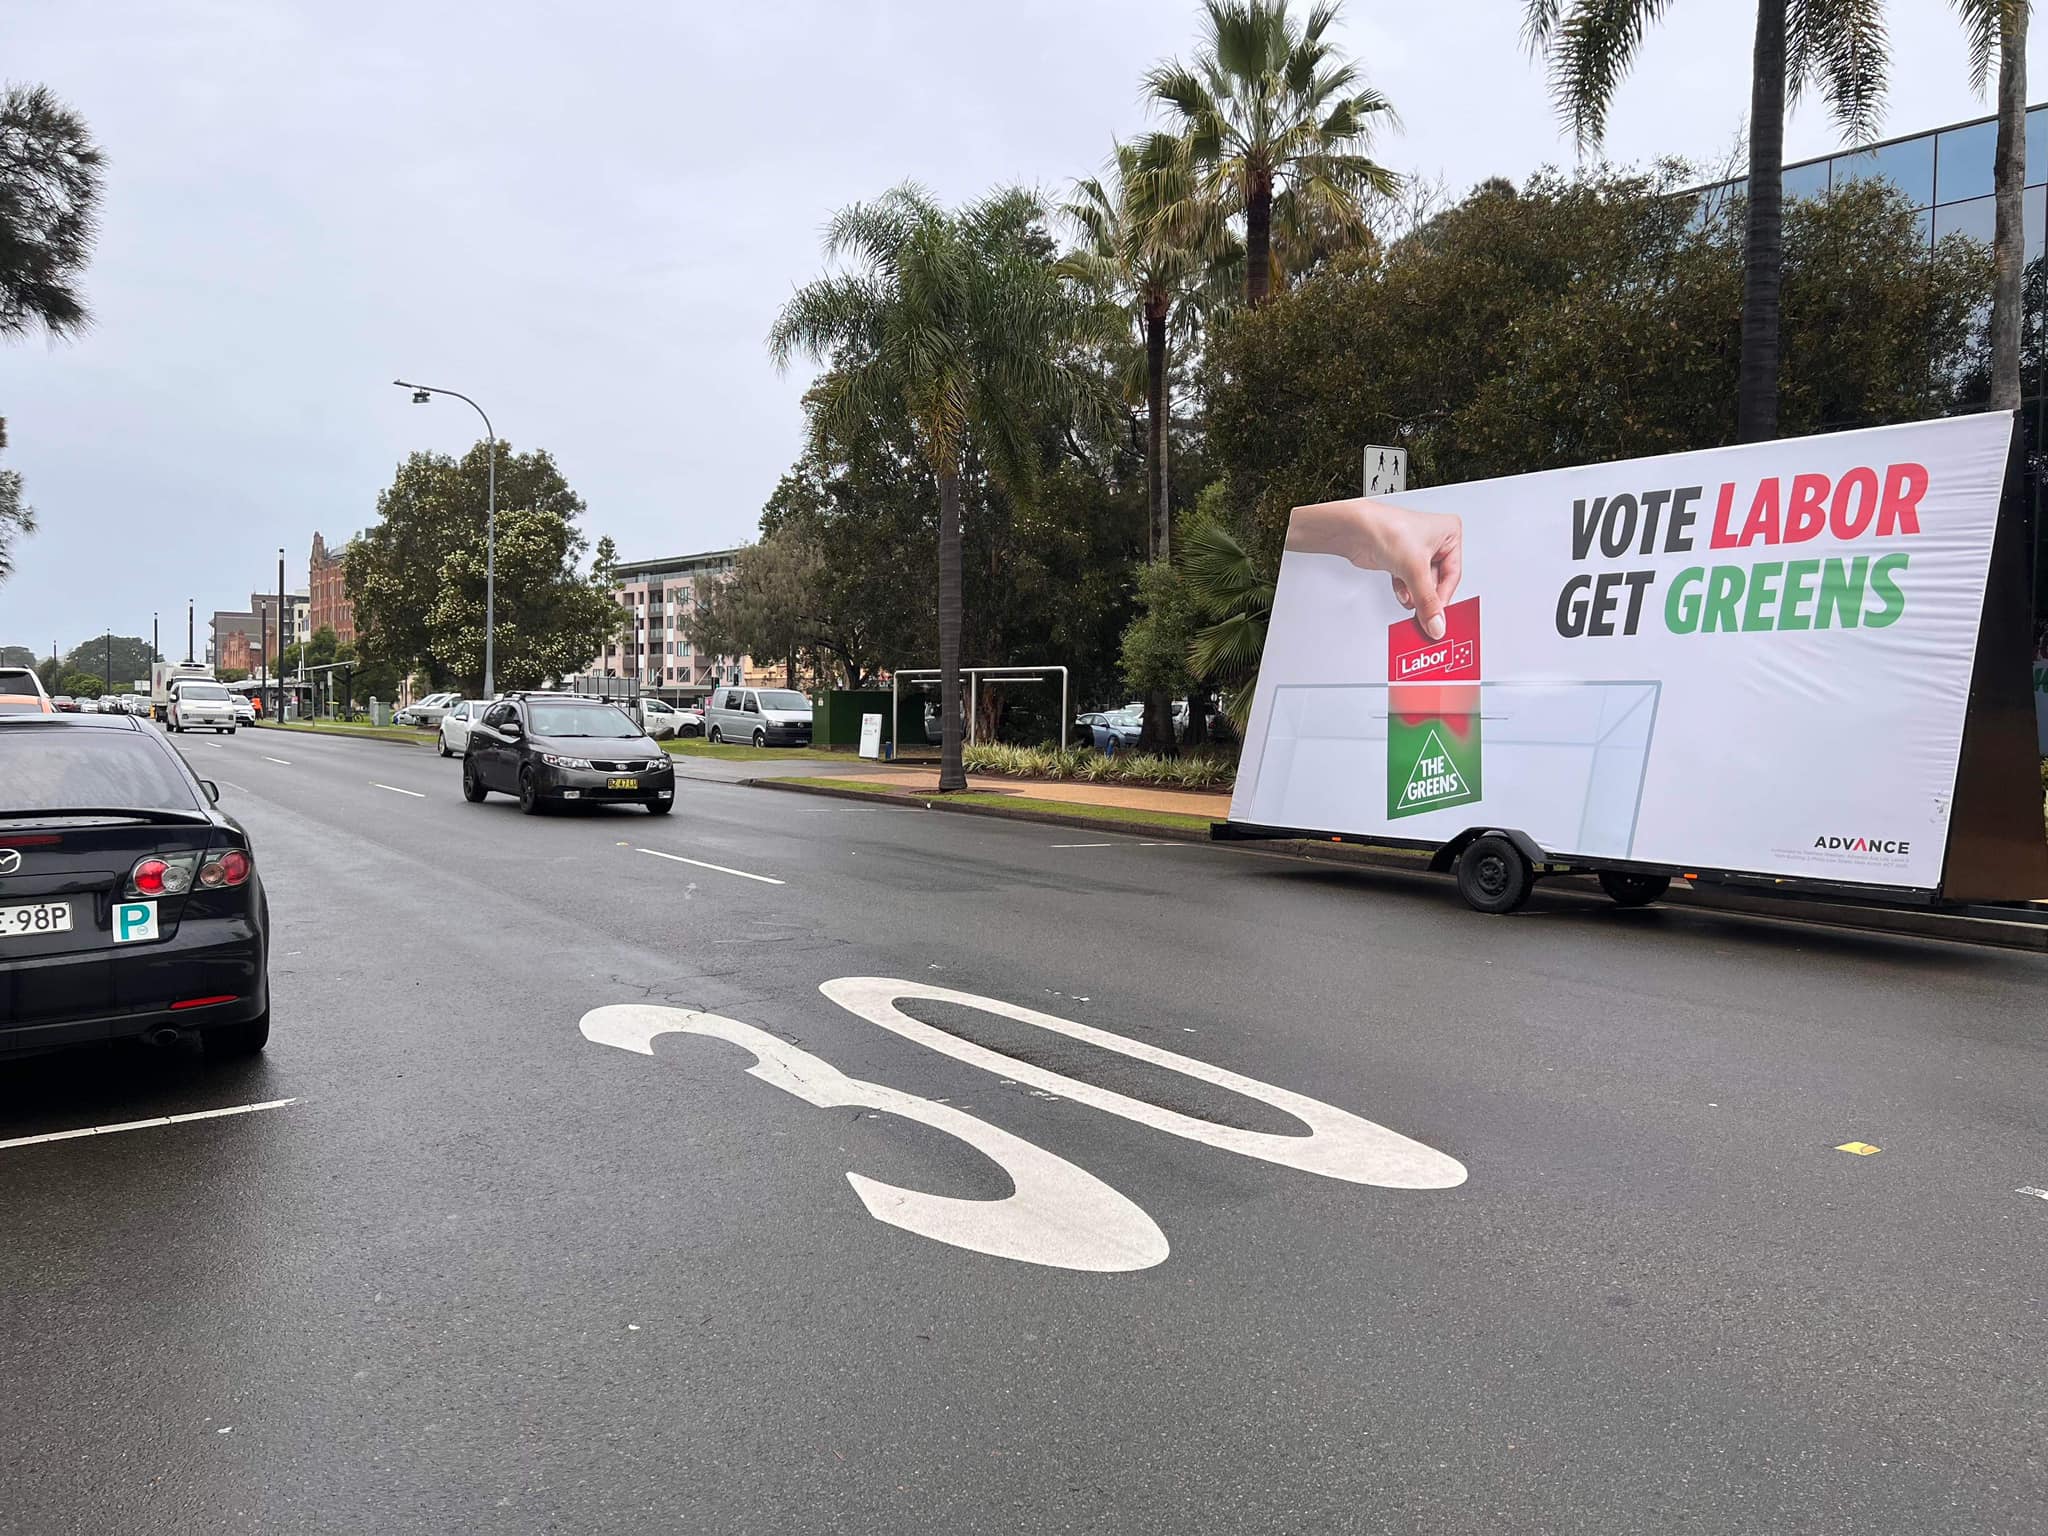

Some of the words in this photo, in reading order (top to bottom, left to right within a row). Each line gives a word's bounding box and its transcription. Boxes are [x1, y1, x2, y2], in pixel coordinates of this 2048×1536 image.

[1573, 486, 1703, 560] VOTE
[1710, 463, 1928, 549] LABOR
[1555, 571, 1656, 638] GET
[1664, 553, 1910, 634] GREENS
[1401, 649, 1448, 674] Labor
[1420, 755, 1445, 778] THE
[1407, 773, 1458, 800] GREENS
[1814, 836, 1910, 854] ADVANCE
[119, 904, 150, 940] P
[580, 976, 1469, 1272] 30
